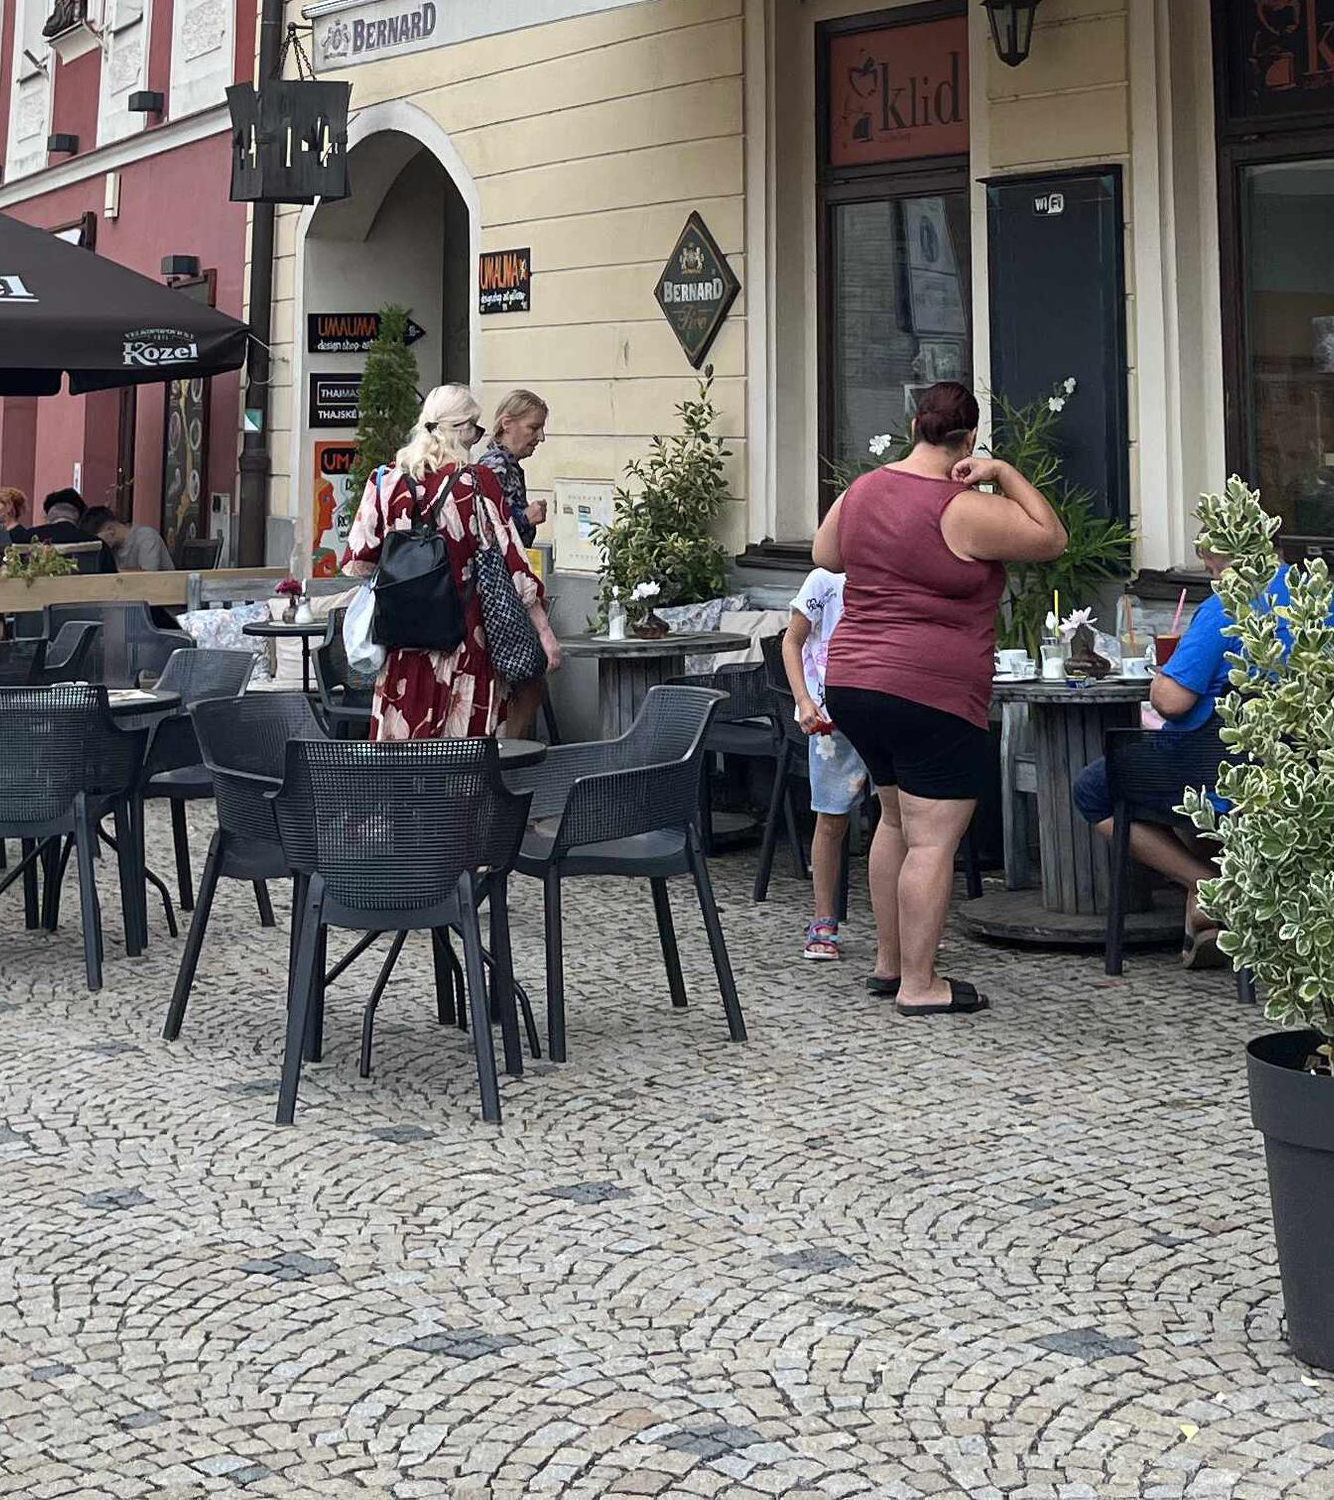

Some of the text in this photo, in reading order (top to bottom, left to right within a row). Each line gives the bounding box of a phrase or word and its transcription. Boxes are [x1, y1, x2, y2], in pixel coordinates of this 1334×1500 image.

[352, 1, 436, 54] BERNARD
[878, 51, 963, 131] klid
[663, 278, 723, 303] BERNARD
[318, 316, 377, 337] UMAUMA
[123, 342, 199, 366] Kozel
[318, 408, 357, 419] THAJSKÉ
